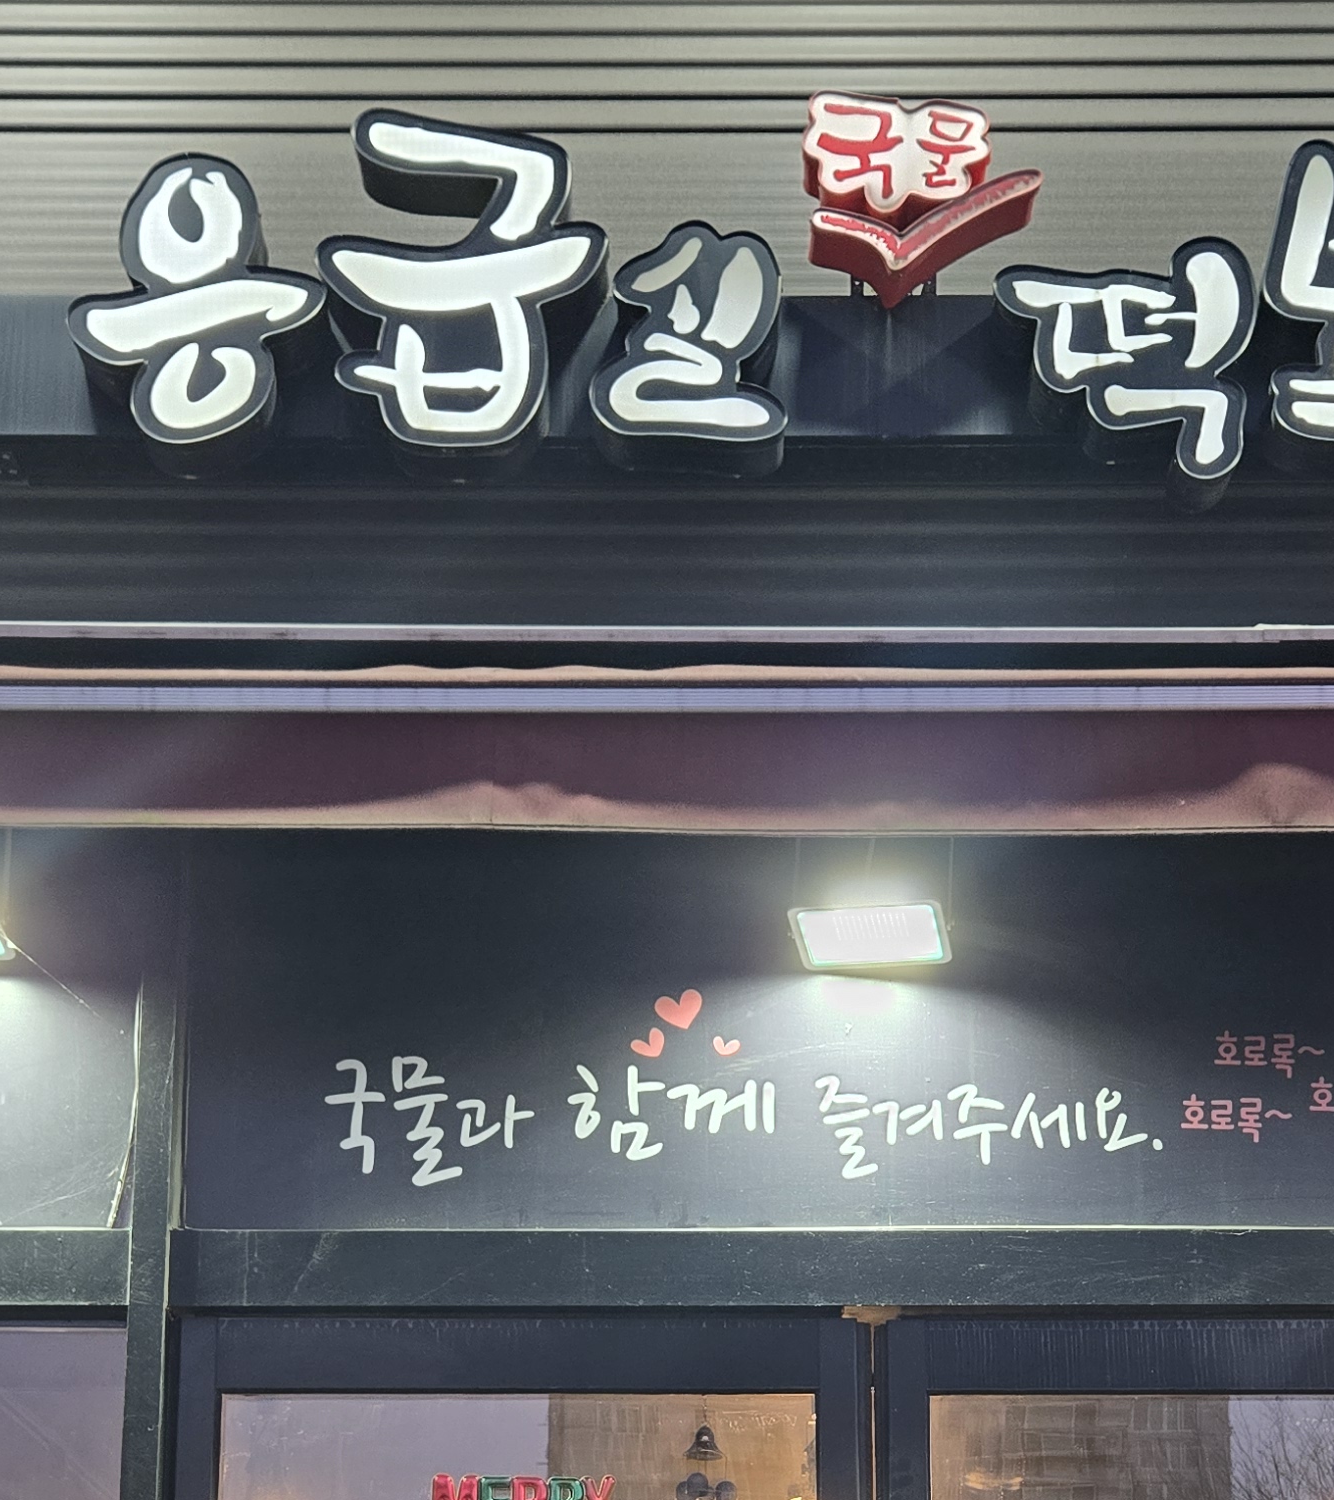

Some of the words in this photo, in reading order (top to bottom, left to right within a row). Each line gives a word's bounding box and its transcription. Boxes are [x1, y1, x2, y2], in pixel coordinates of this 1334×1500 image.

[815, 102, 978, 199] 국물
[77, 114, 777, 438] 응급실
[323, 1055, 535, 1188] 국물과
[566, 1064, 777, 1162] 함께
[814, 1074, 1164, 1180] 즐겨주세요.
